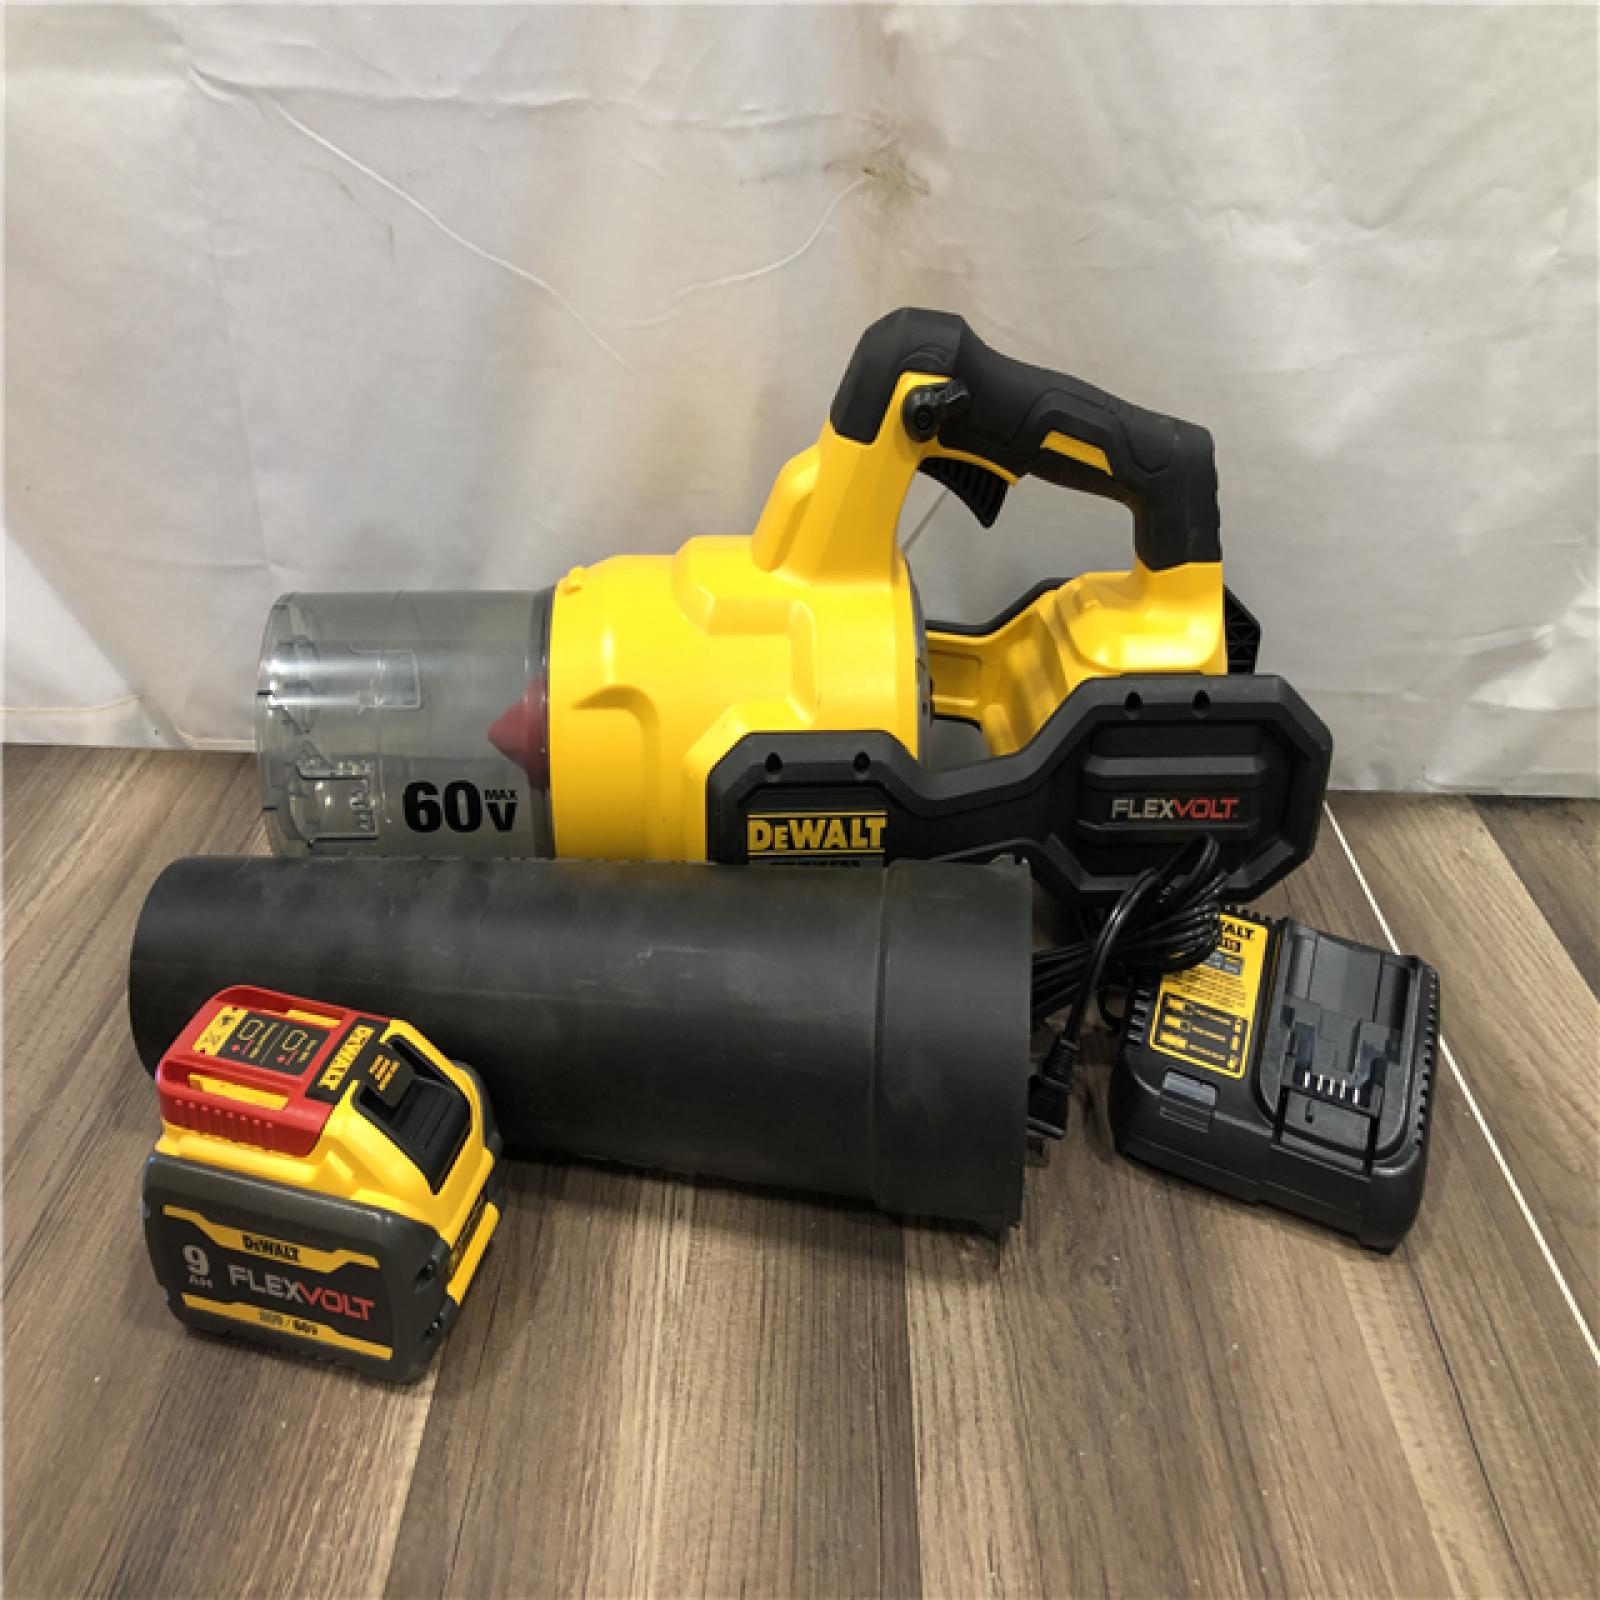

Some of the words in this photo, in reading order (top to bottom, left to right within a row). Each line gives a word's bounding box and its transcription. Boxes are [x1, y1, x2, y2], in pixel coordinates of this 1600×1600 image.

[1111, 798, 1240, 819] FLEXVOLT
[183, 1245, 209, 1275] 9
[228, 1263, 376, 1322] FLEXVOLT
